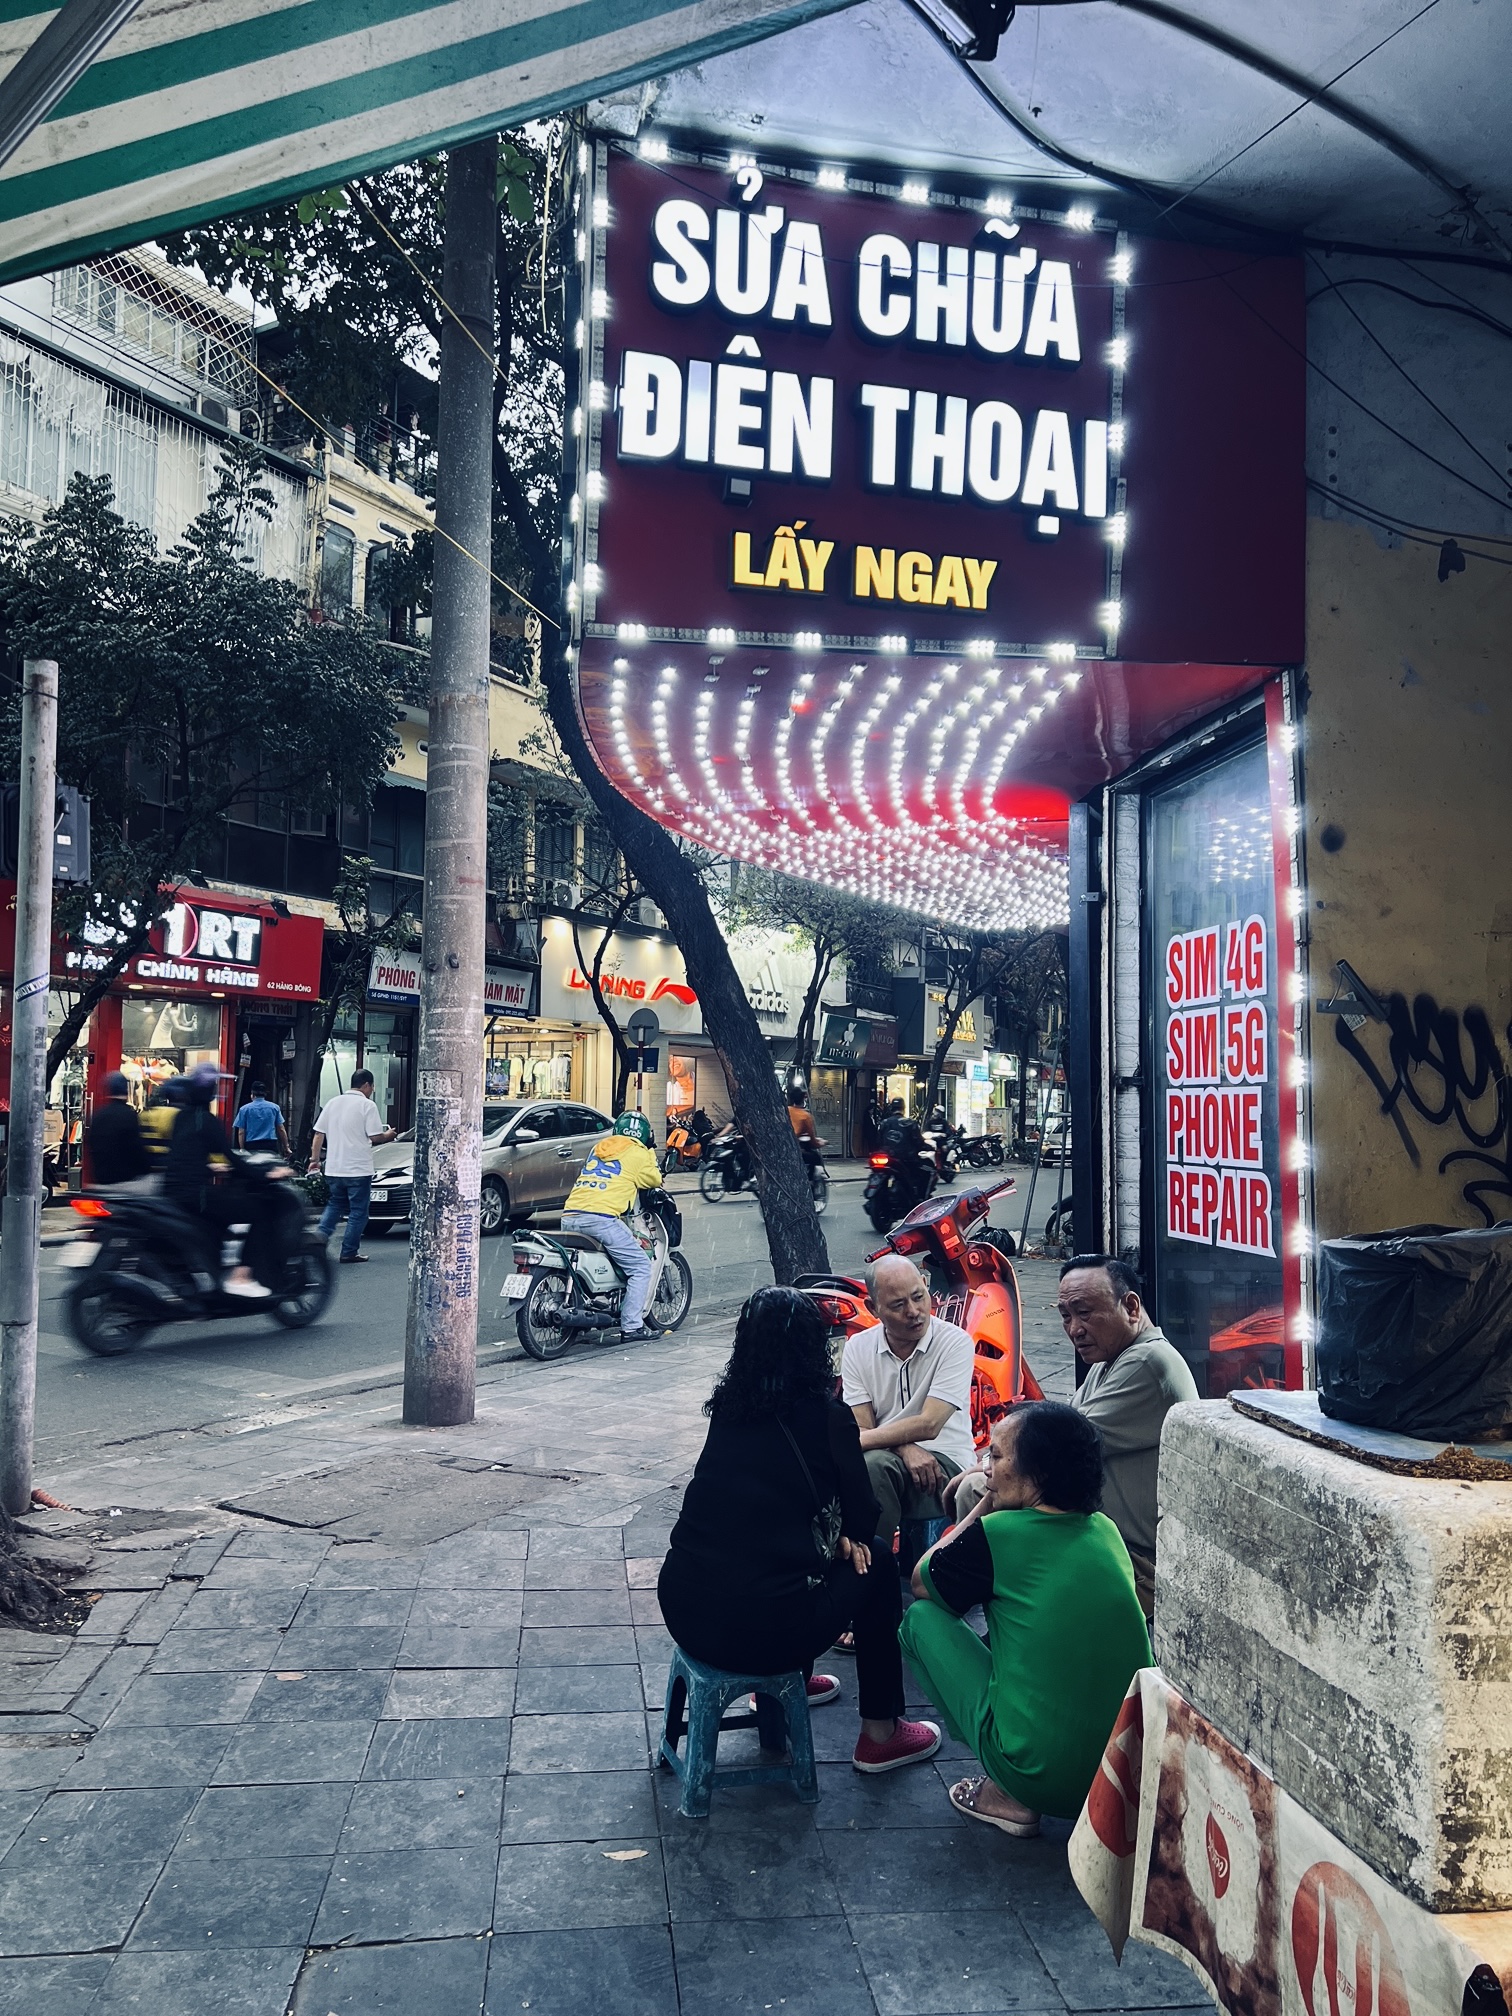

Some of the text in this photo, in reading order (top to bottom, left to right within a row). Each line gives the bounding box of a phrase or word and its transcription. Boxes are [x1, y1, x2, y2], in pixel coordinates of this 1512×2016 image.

[652, 167, 1081, 362] SỬA CHỮA
[617, 335, 1108, 535] ĐIỆN THOẠI
[733, 520, 998, 609] LẤY NGAY
[66, 950, 260, 988] HÀN CHÍNH HÃNG
[267, 981, 312, 993] 62 HÀNG BÔNG
[377, 964, 416, 989] PHÒNG
[505, 983, 525, 1007] MẶT
[569, 968, 646, 998] LNING
[1169, 921, 1263, 1003] SIM 4G
[747, 989, 790, 1013] adidas
[1169, 1008, 1263, 1080] SIM 5G
[622, 1127, 642, 1138] Grab
[1169, 1094, 1259, 1162] PHONE
[1169, 1170, 1269, 1249] REPAIR
[985, 1307, 1005, 1319] HONDA
